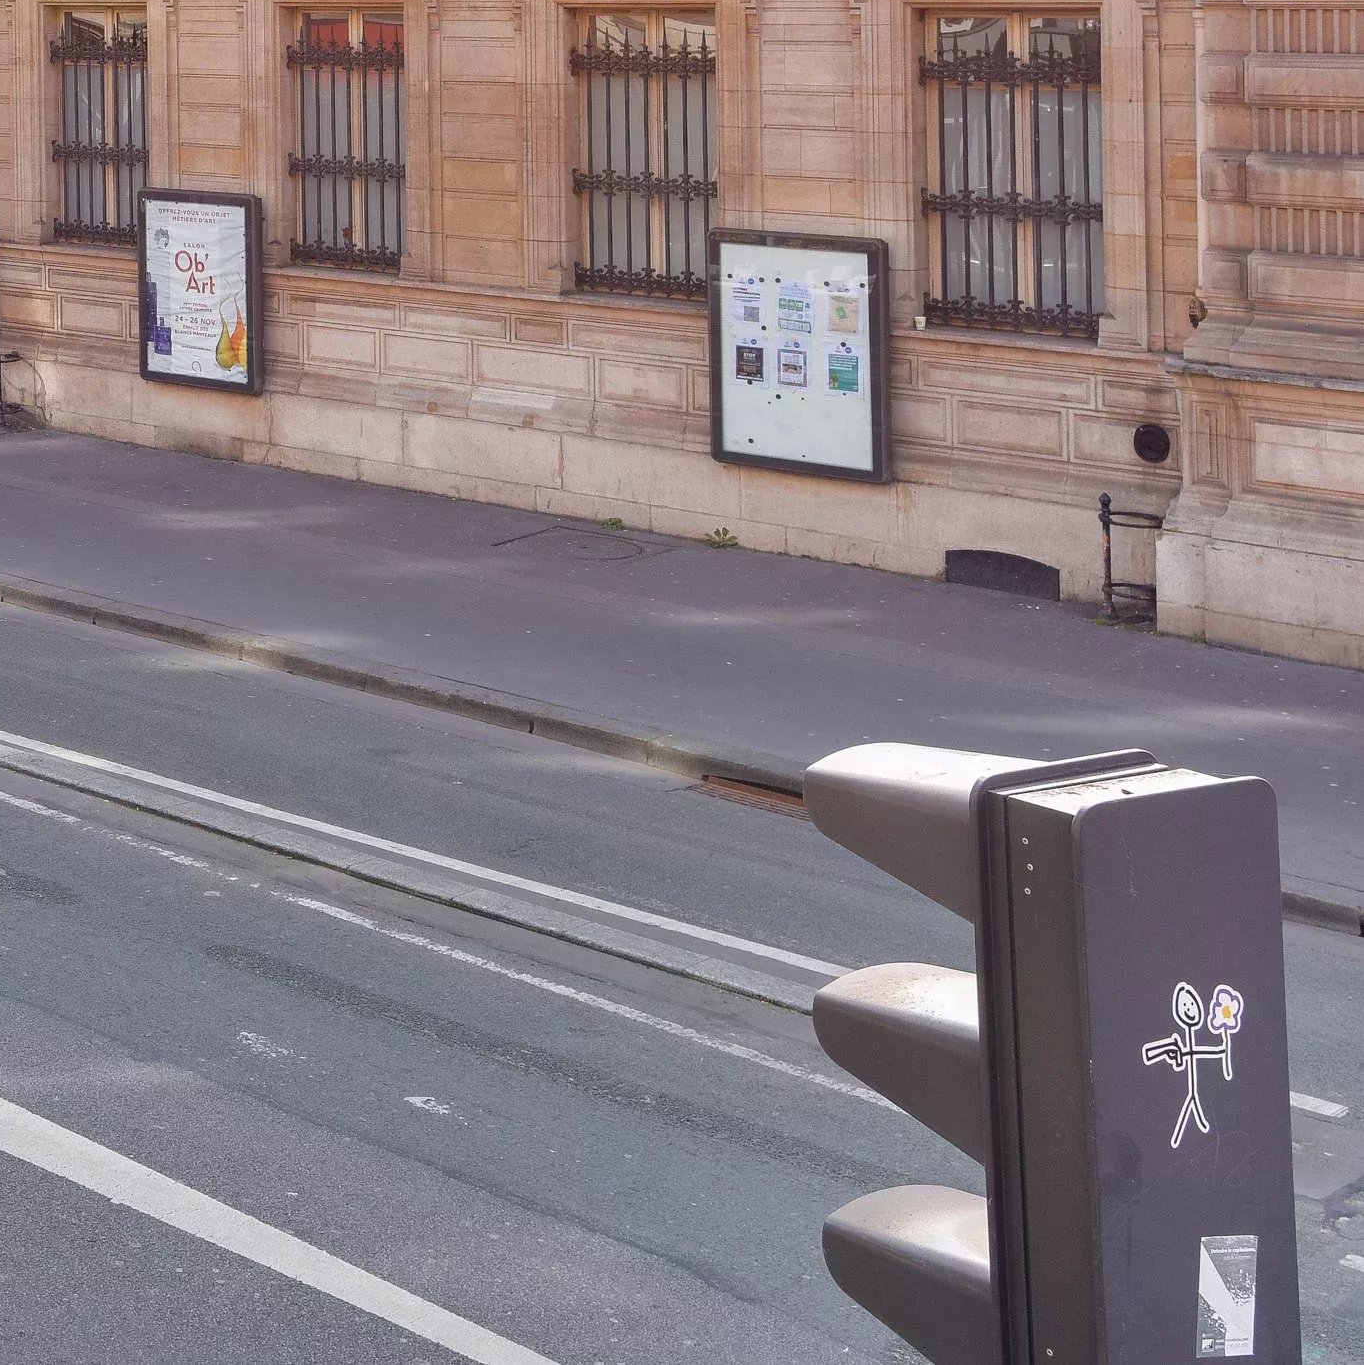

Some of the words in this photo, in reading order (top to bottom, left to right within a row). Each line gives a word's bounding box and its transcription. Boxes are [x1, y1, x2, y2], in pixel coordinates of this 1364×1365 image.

[158, 208, 199, 216] OFFREZ-VOUS
[174, 250, 209, 273] Ob'
[185, 271, 215, 295] Art
